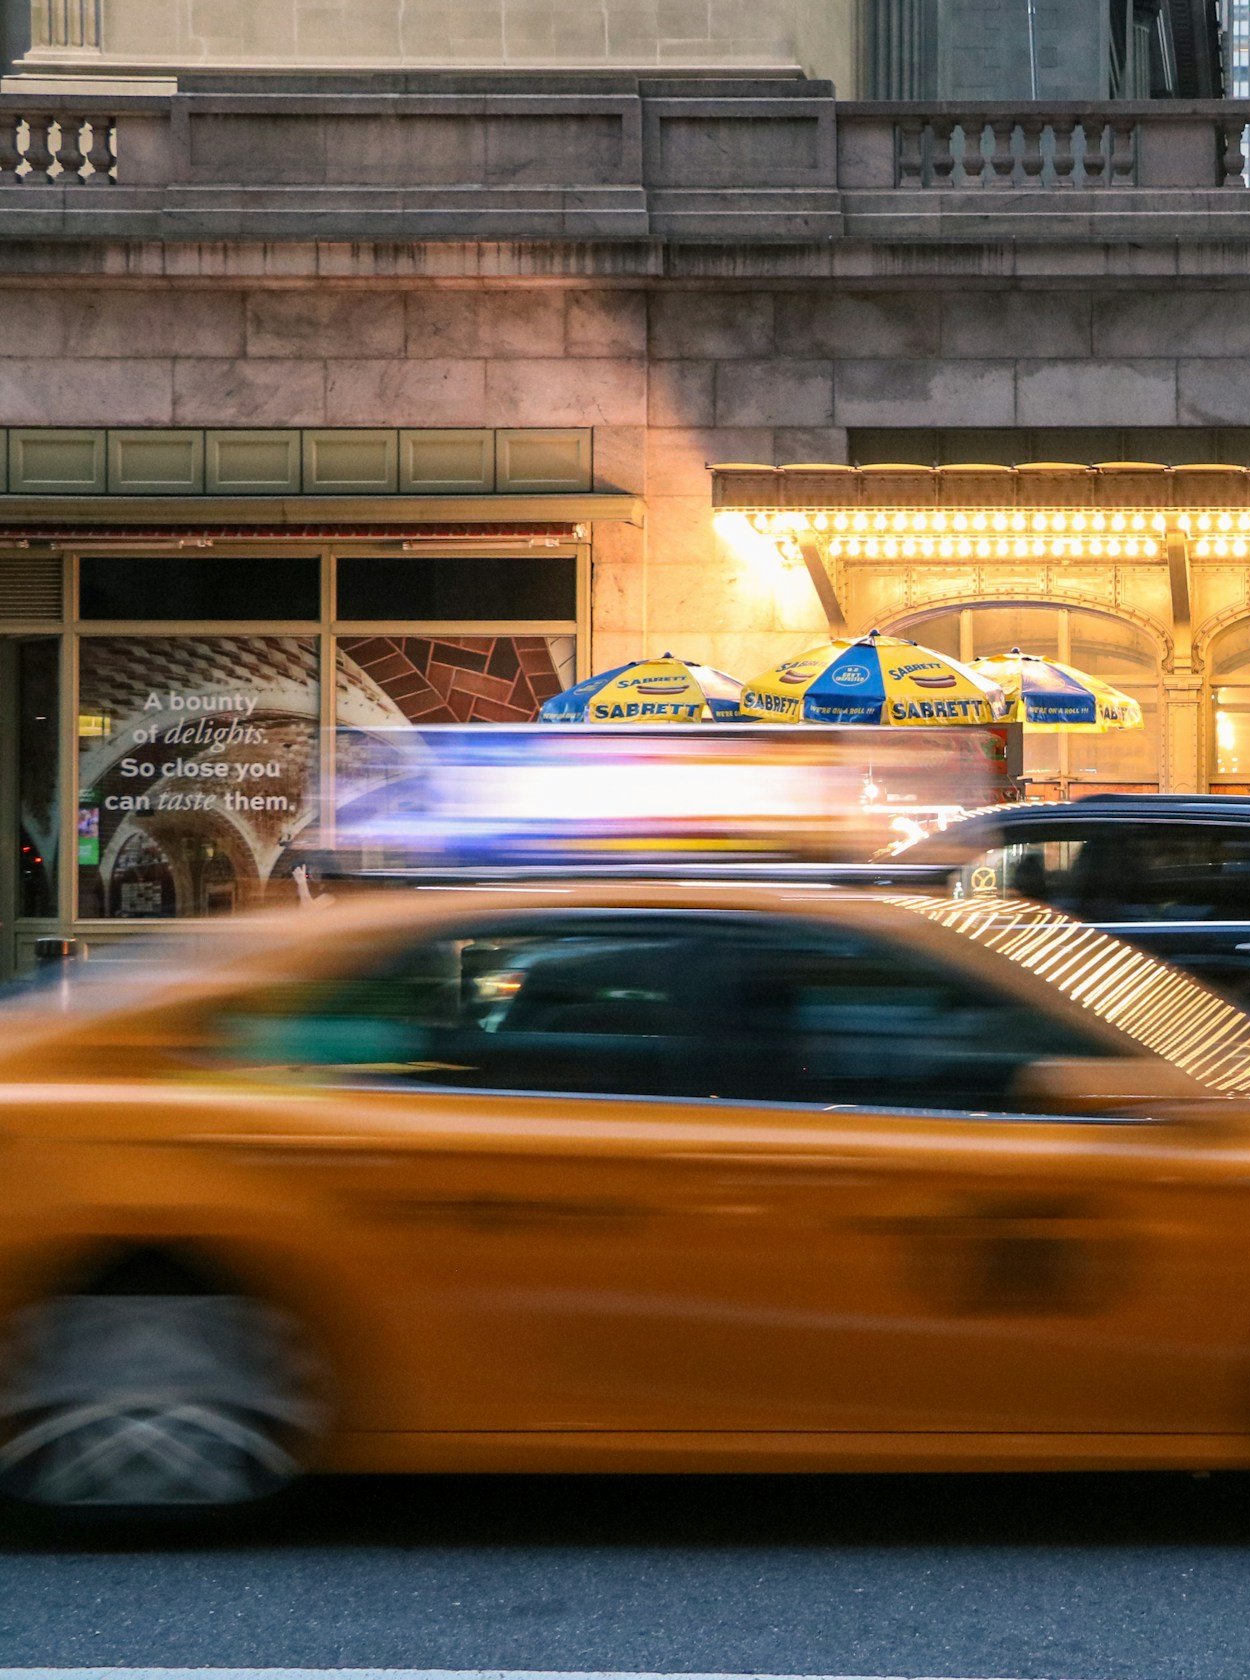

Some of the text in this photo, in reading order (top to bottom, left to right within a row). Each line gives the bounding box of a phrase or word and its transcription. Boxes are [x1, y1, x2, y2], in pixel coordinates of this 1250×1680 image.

[617, 675, 687, 688] SABRETT
[888, 663, 942, 680] SABRETT
[144, 690, 257, 716] A bounty
[595, 703, 699, 719] SABRETT
[743, 691, 800, 715] SABRETT
[850, 707, 865, 715] ROLL
[866, 706, 875, 715] !!!
[893, 700, 983, 720] SABRETT
[132, 717, 269, 753] of delights.
[120, 757, 280, 782] So close you
[104, 794, 150, 811] can
[157, 792, 217, 811] taste
[223, 791, 296, 811] them.
